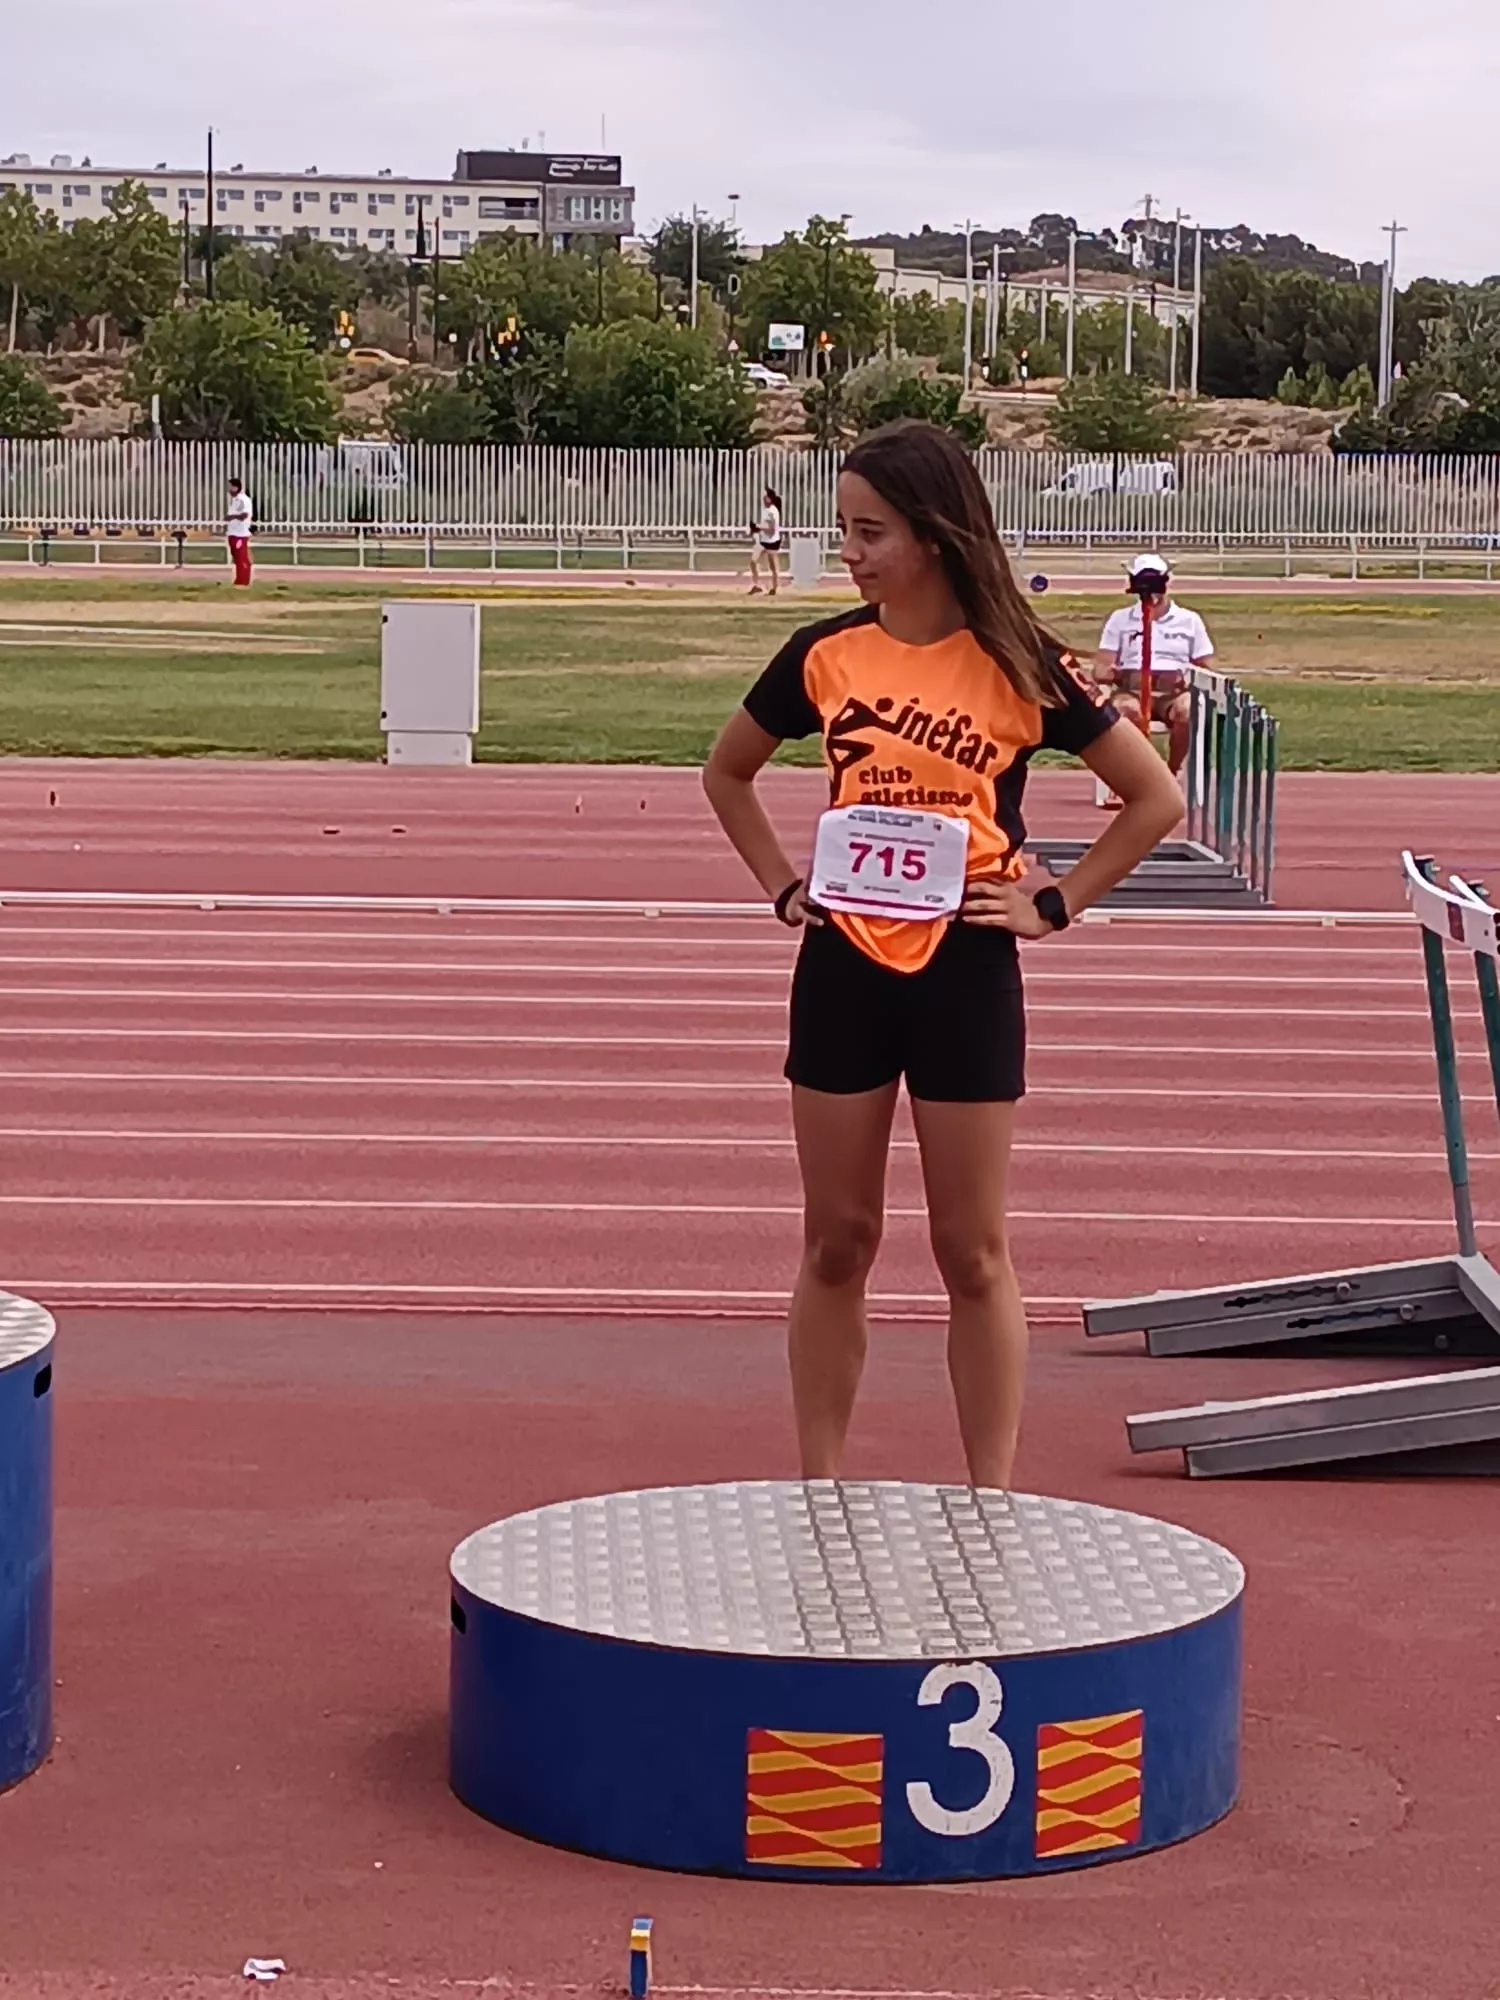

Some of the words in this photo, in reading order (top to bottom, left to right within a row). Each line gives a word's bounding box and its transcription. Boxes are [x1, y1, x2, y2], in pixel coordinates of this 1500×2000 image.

[858, 765, 912, 784] club
[849, 842, 926, 881] 715
[906, 1661, 1015, 1836] 3
